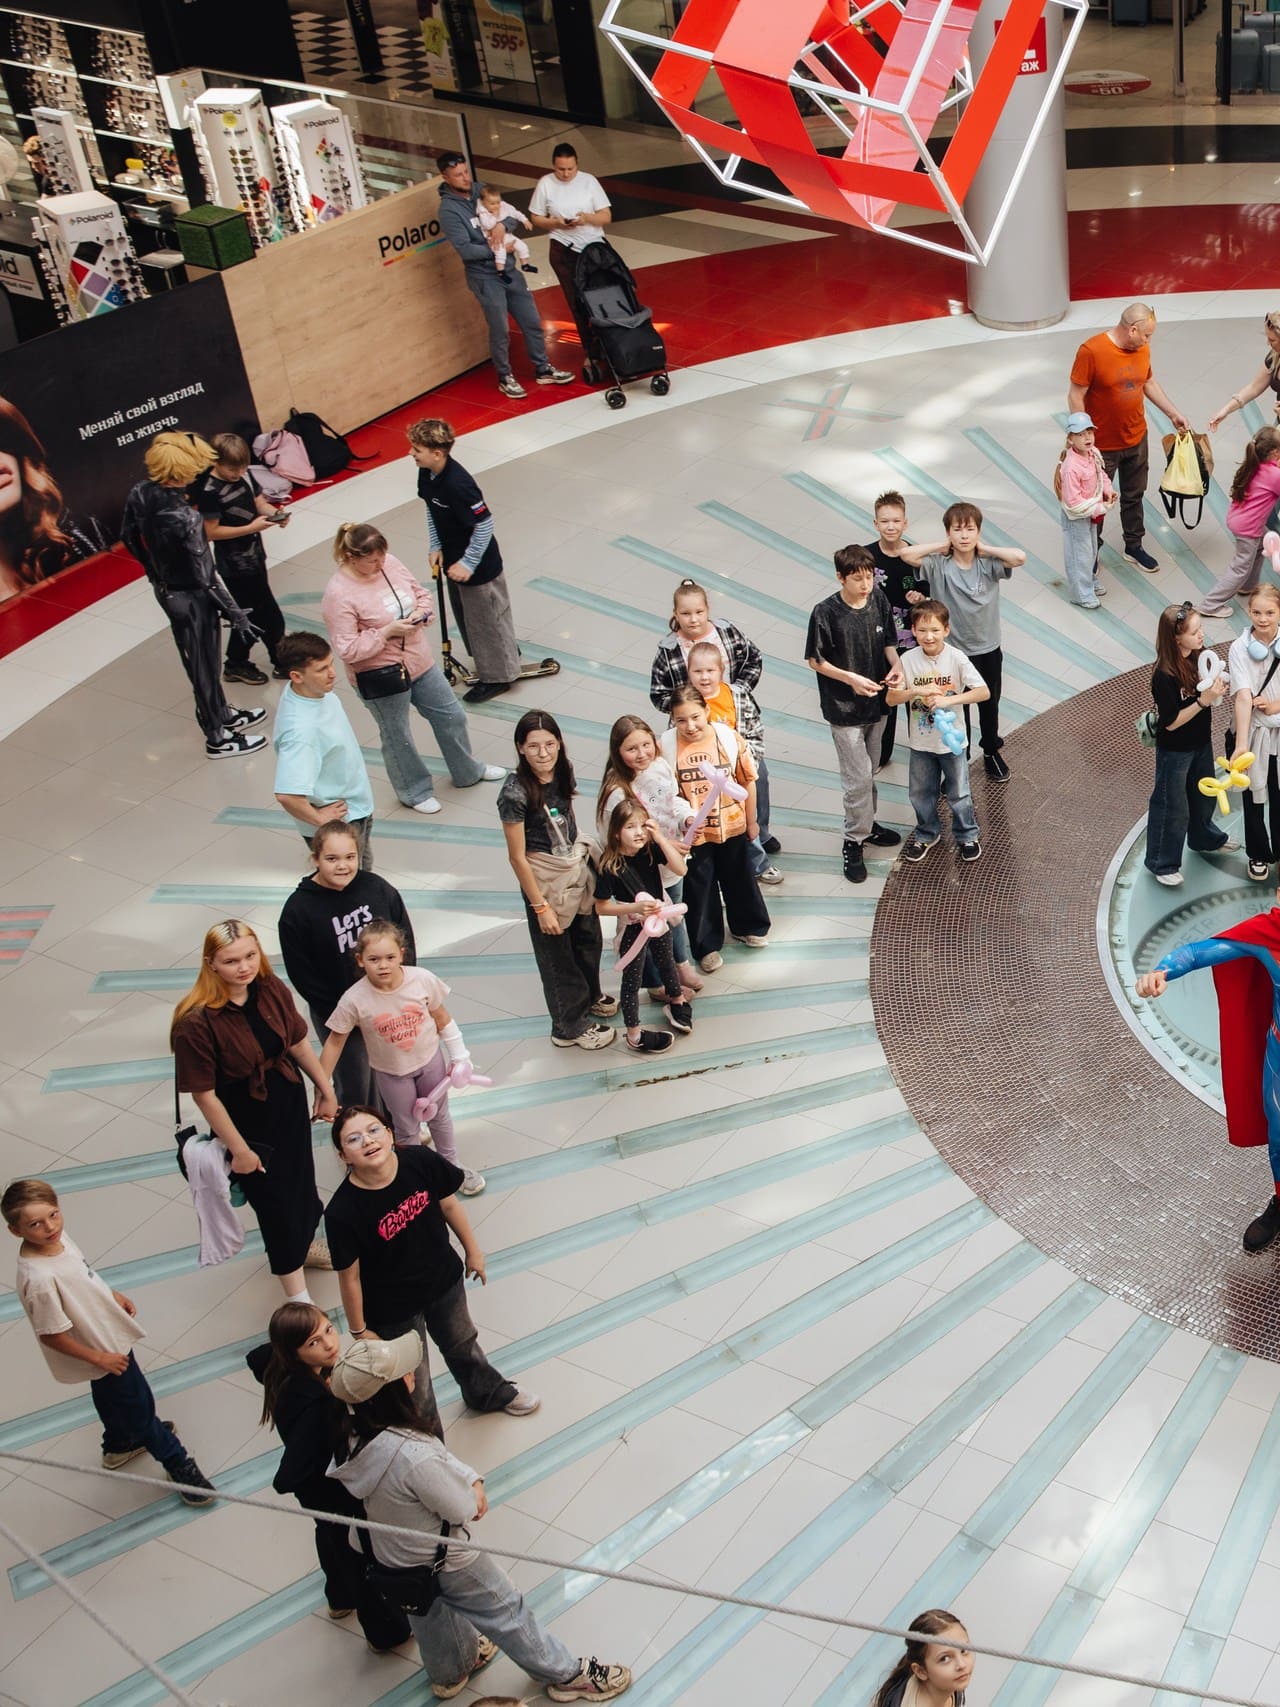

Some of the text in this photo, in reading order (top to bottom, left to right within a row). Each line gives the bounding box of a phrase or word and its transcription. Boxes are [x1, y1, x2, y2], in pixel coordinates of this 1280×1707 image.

[1018, 60, 1040, 72] аж
[309, 116, 340, 128] Polaroid
[76, 210, 115, 225] Polaroid
[378, 219, 441, 258] Polaro
[78, 382, 205, 441] Меняй свой взгляд
[116, 432, 135, 447] на
[913, 675, 952, 687] GAME VIBE
[380, 1193, 428, 1240] Barbie
